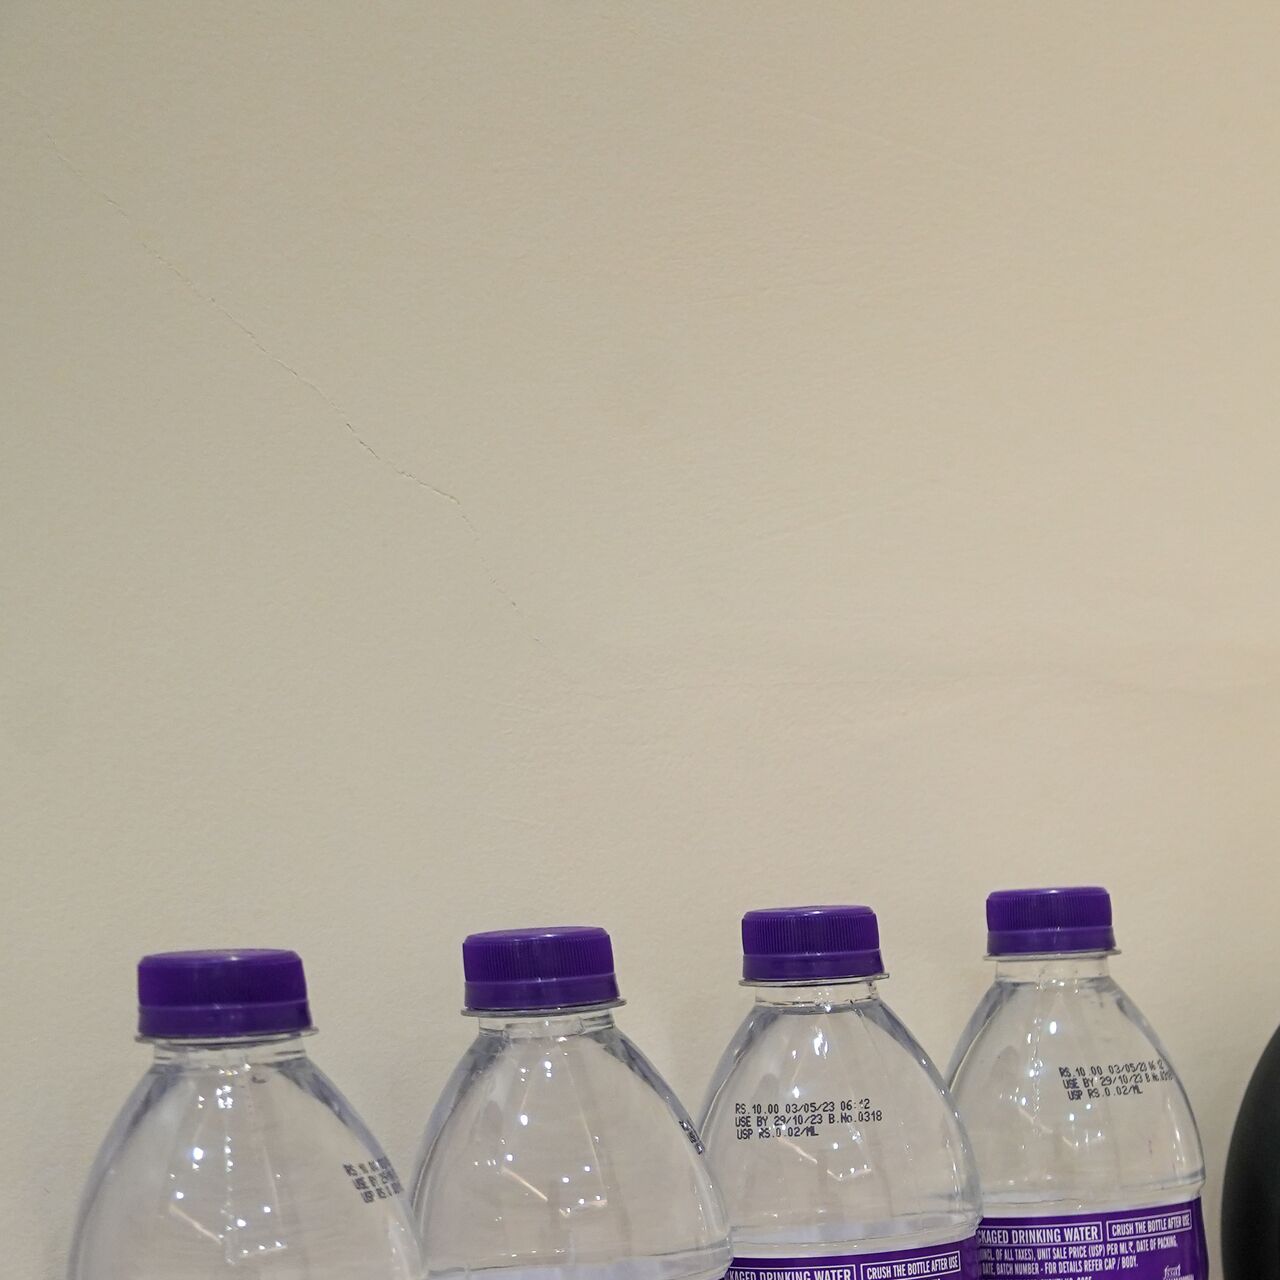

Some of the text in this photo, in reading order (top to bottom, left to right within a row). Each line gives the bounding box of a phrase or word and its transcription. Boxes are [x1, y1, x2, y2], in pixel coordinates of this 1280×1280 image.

[1062, 1078, 1080, 1089] USE
[1082, 1076, 1095, 1088] BY
[1067, 1089, 1083, 1101] USP
[785, 1101, 835, 1113] 03/05/23
[735, 1115, 751, 1127] USE
[756, 1115, 769, 1127] BY
[773, 1113, 823, 1126] 29/10/23
[736, 1128, 754, 1140] USP
[1111, 1213, 1190, 1237] CRUSH THE BOTTLE AFTER USE
[1010, 1227, 1063, 1245] DRINKING
[1061, 1225, 1099, 1244] WATER
[866, 1253, 959, 1280] CRUSH THE BOTTLE AFTER USE
